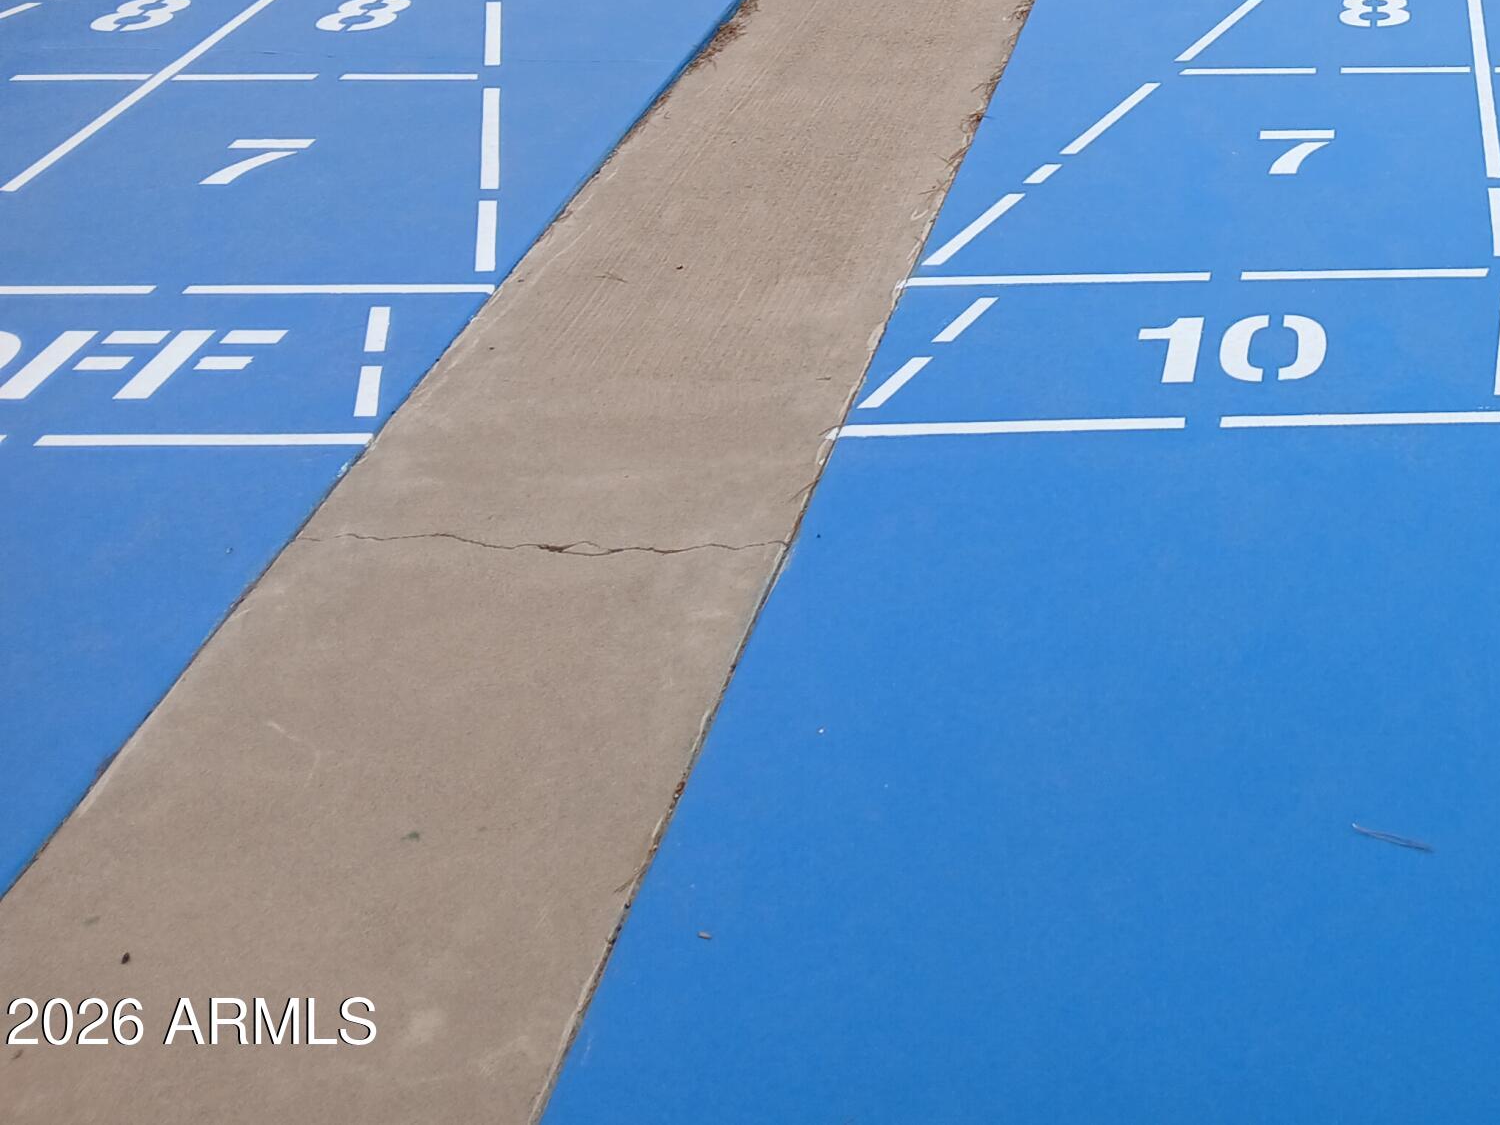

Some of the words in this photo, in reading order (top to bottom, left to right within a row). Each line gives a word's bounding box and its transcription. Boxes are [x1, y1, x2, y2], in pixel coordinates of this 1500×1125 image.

[199, 138, 316, 185] 7
[1258, 129, 1336, 175] 7
[0, 329, 289, 400] FF
[1137, 313, 1328, 383] 10
